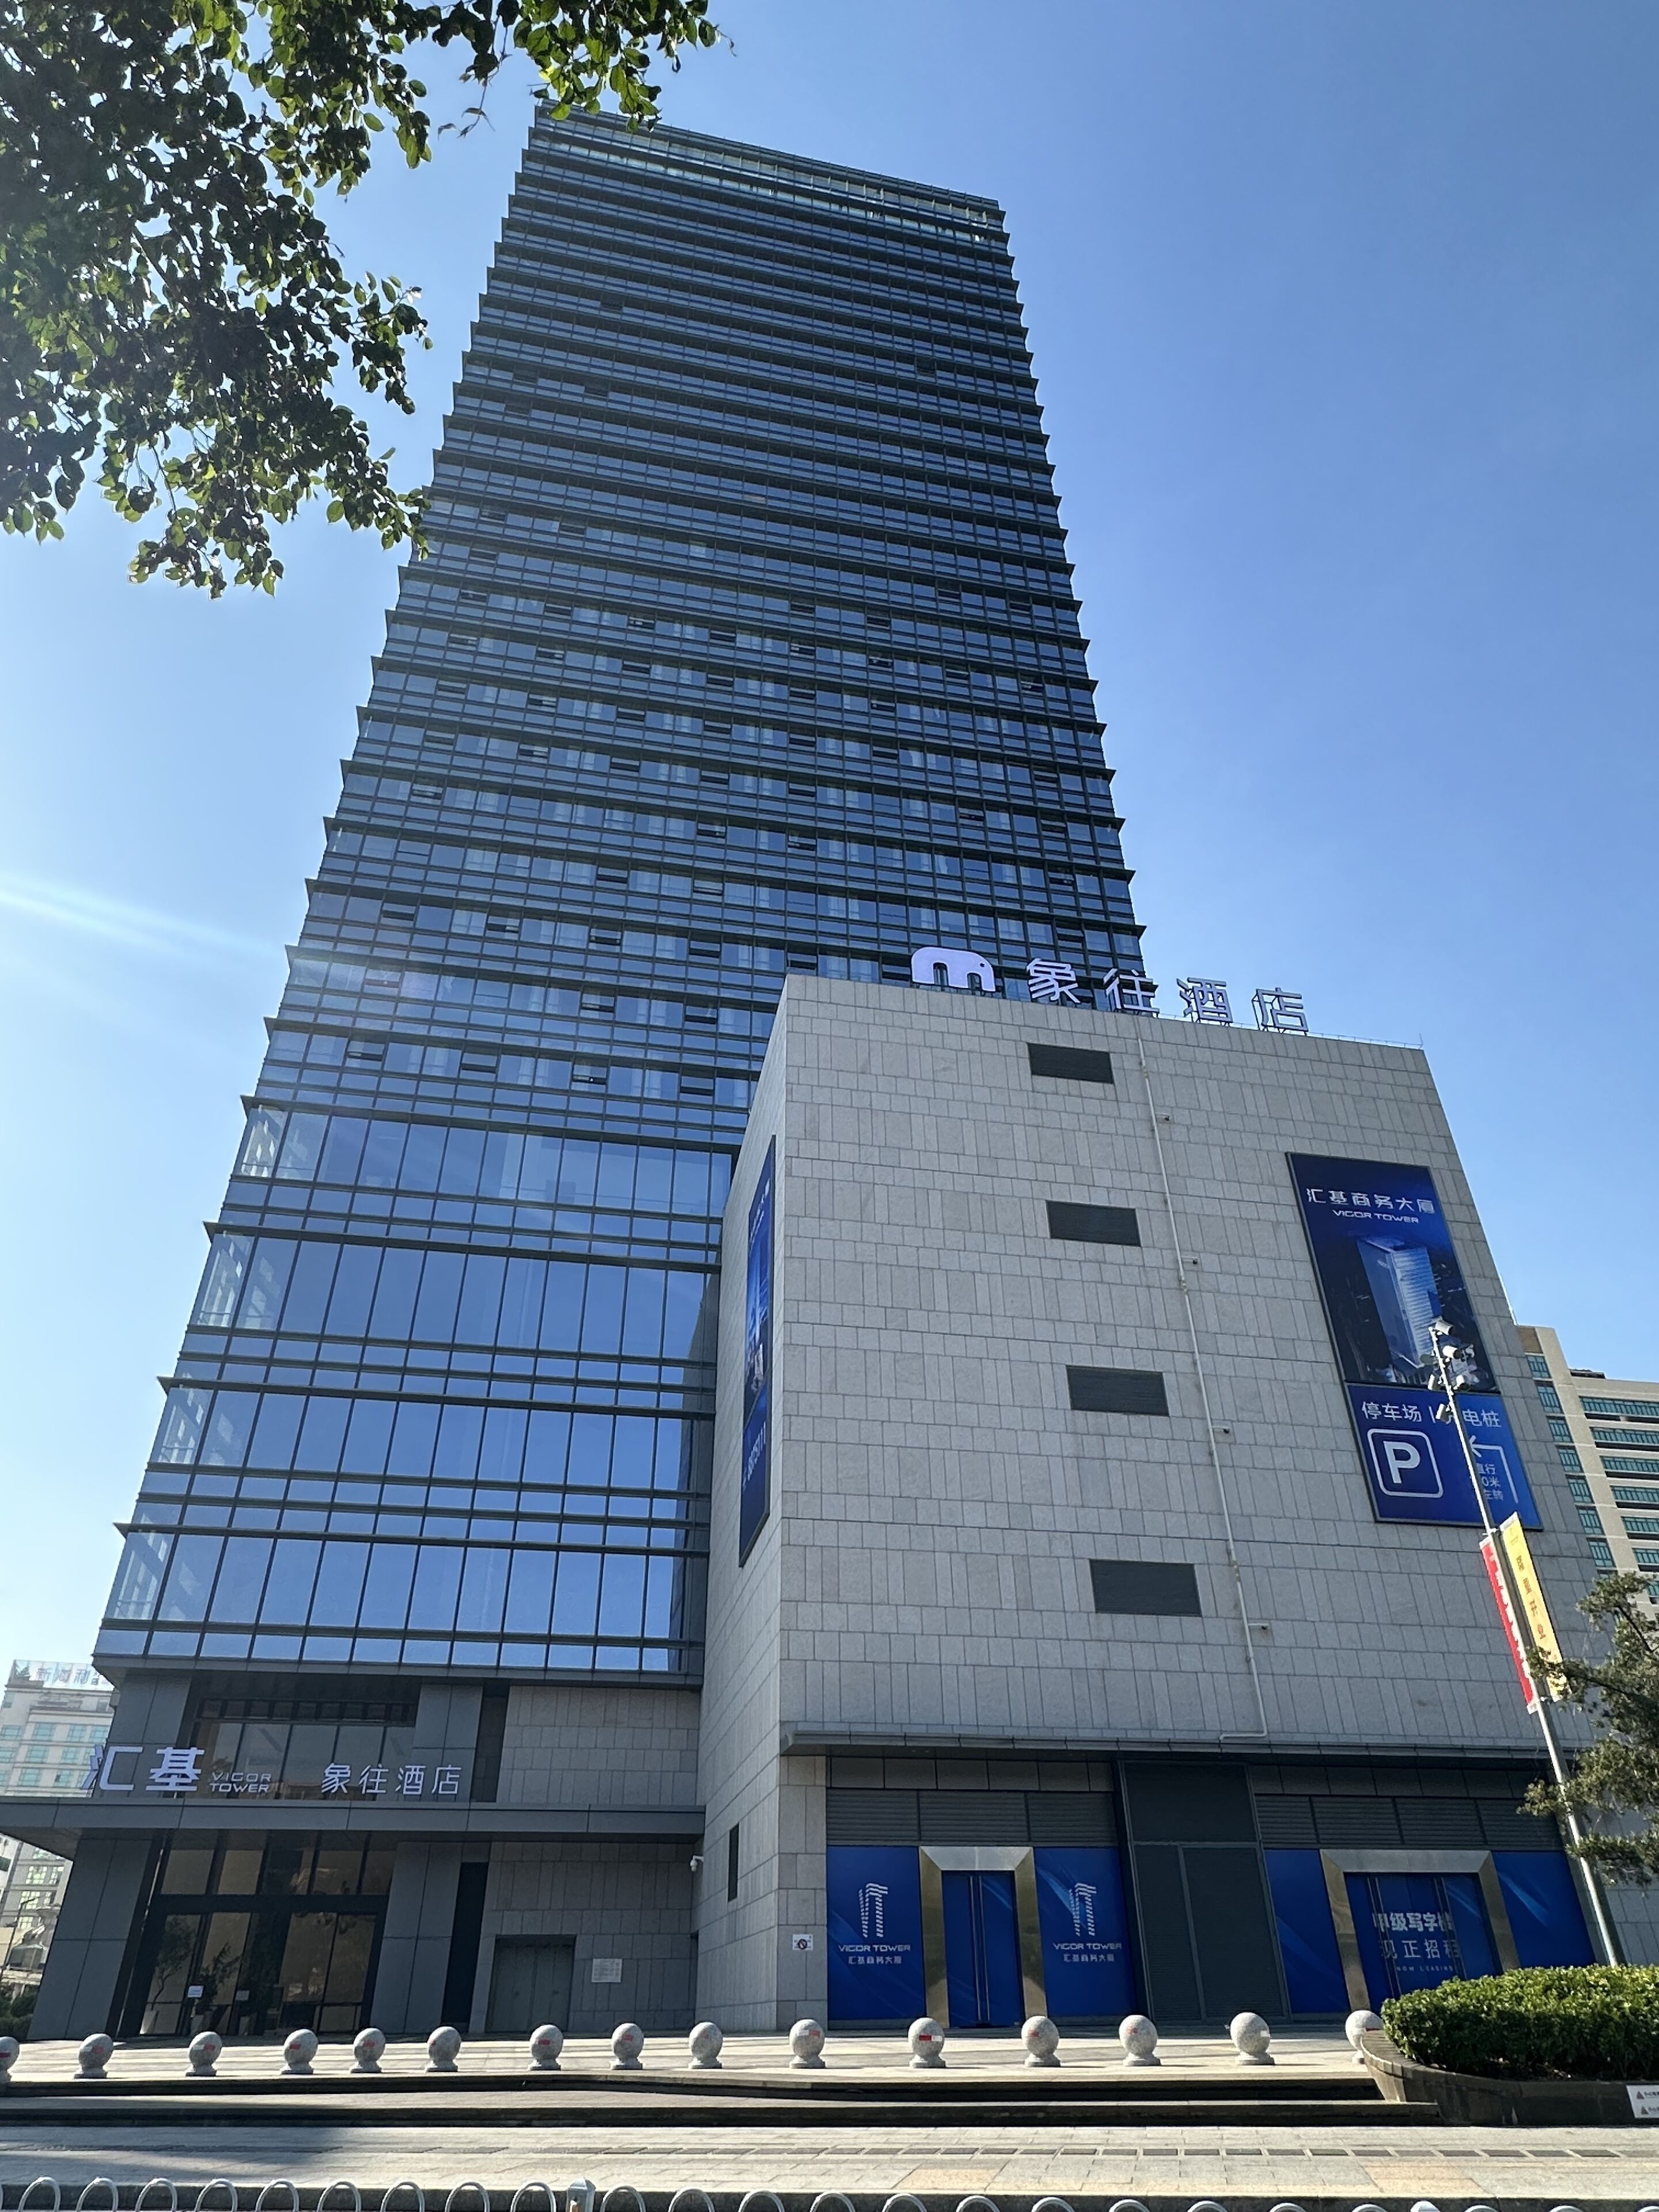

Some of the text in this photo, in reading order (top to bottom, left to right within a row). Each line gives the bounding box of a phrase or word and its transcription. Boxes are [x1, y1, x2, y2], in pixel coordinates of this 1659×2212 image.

[1026, 958, 1309, 1032] 象往酒店
[1306, 1188, 1435, 1214] 汇基商务大厦
[1332, 1209, 1419, 1224] VIGOR TOWER
[1362, 1401, 1502, 1427] 停车场 电桩
[1383, 1441, 1421, 1483] P
[80, 1745, 204, 1791] 汇基
[211, 1772, 272, 1782] VIGOR
[321, 1763, 461, 1794] 象往酒店
[209, 1783, 270, 1793] TOWER
